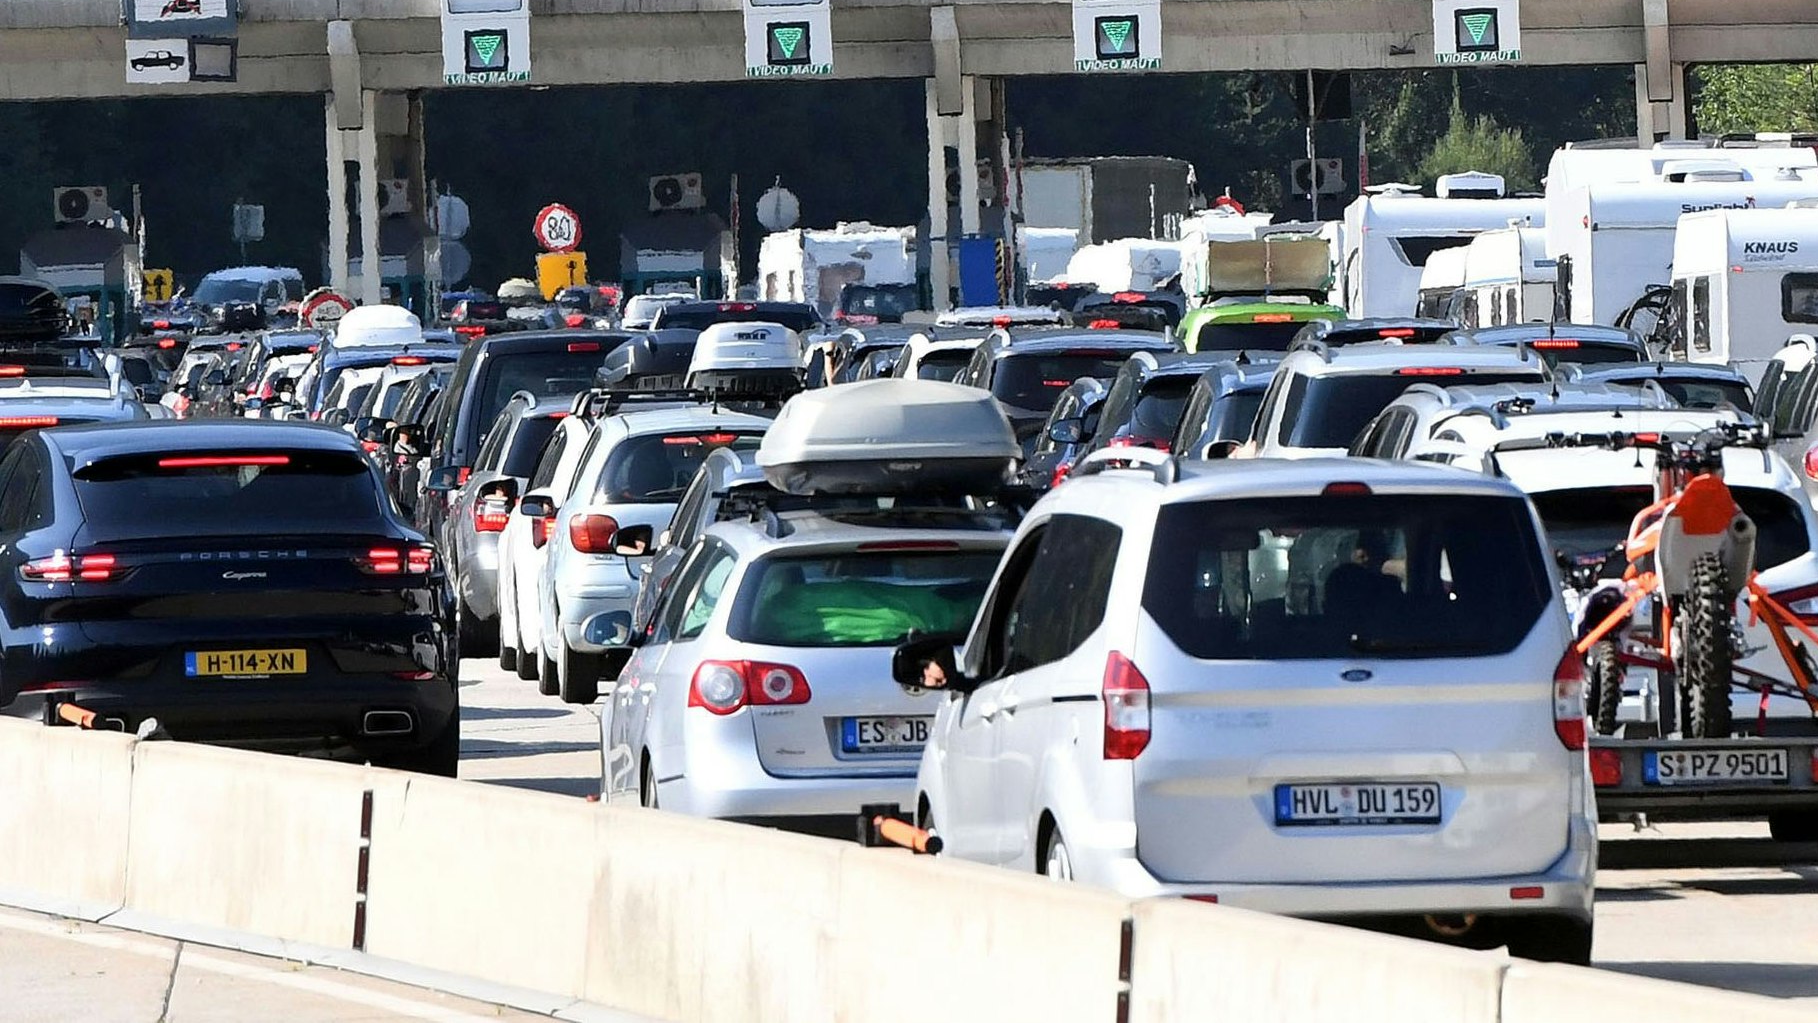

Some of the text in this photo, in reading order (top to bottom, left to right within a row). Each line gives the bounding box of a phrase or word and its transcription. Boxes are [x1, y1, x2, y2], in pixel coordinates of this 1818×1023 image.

[1442, 50, 1514, 63] VIDEO MAUT
[753, 63, 827, 76] VIDEO MAUT
[1082, 58, 1155, 71] VIDEO MAUT
[451, 70, 525, 84] VIDEO MAUT
[1743, 242, 1799, 253] KNAUS
[180, 550, 307, 560] PORSCHE
[207, 653, 295, 673] H-114-XN
[858, 720, 885, 744] ES
[1660, 753, 1785, 777] S PZ 9501
[1293, 787, 1435, 814] HVL DU 159
